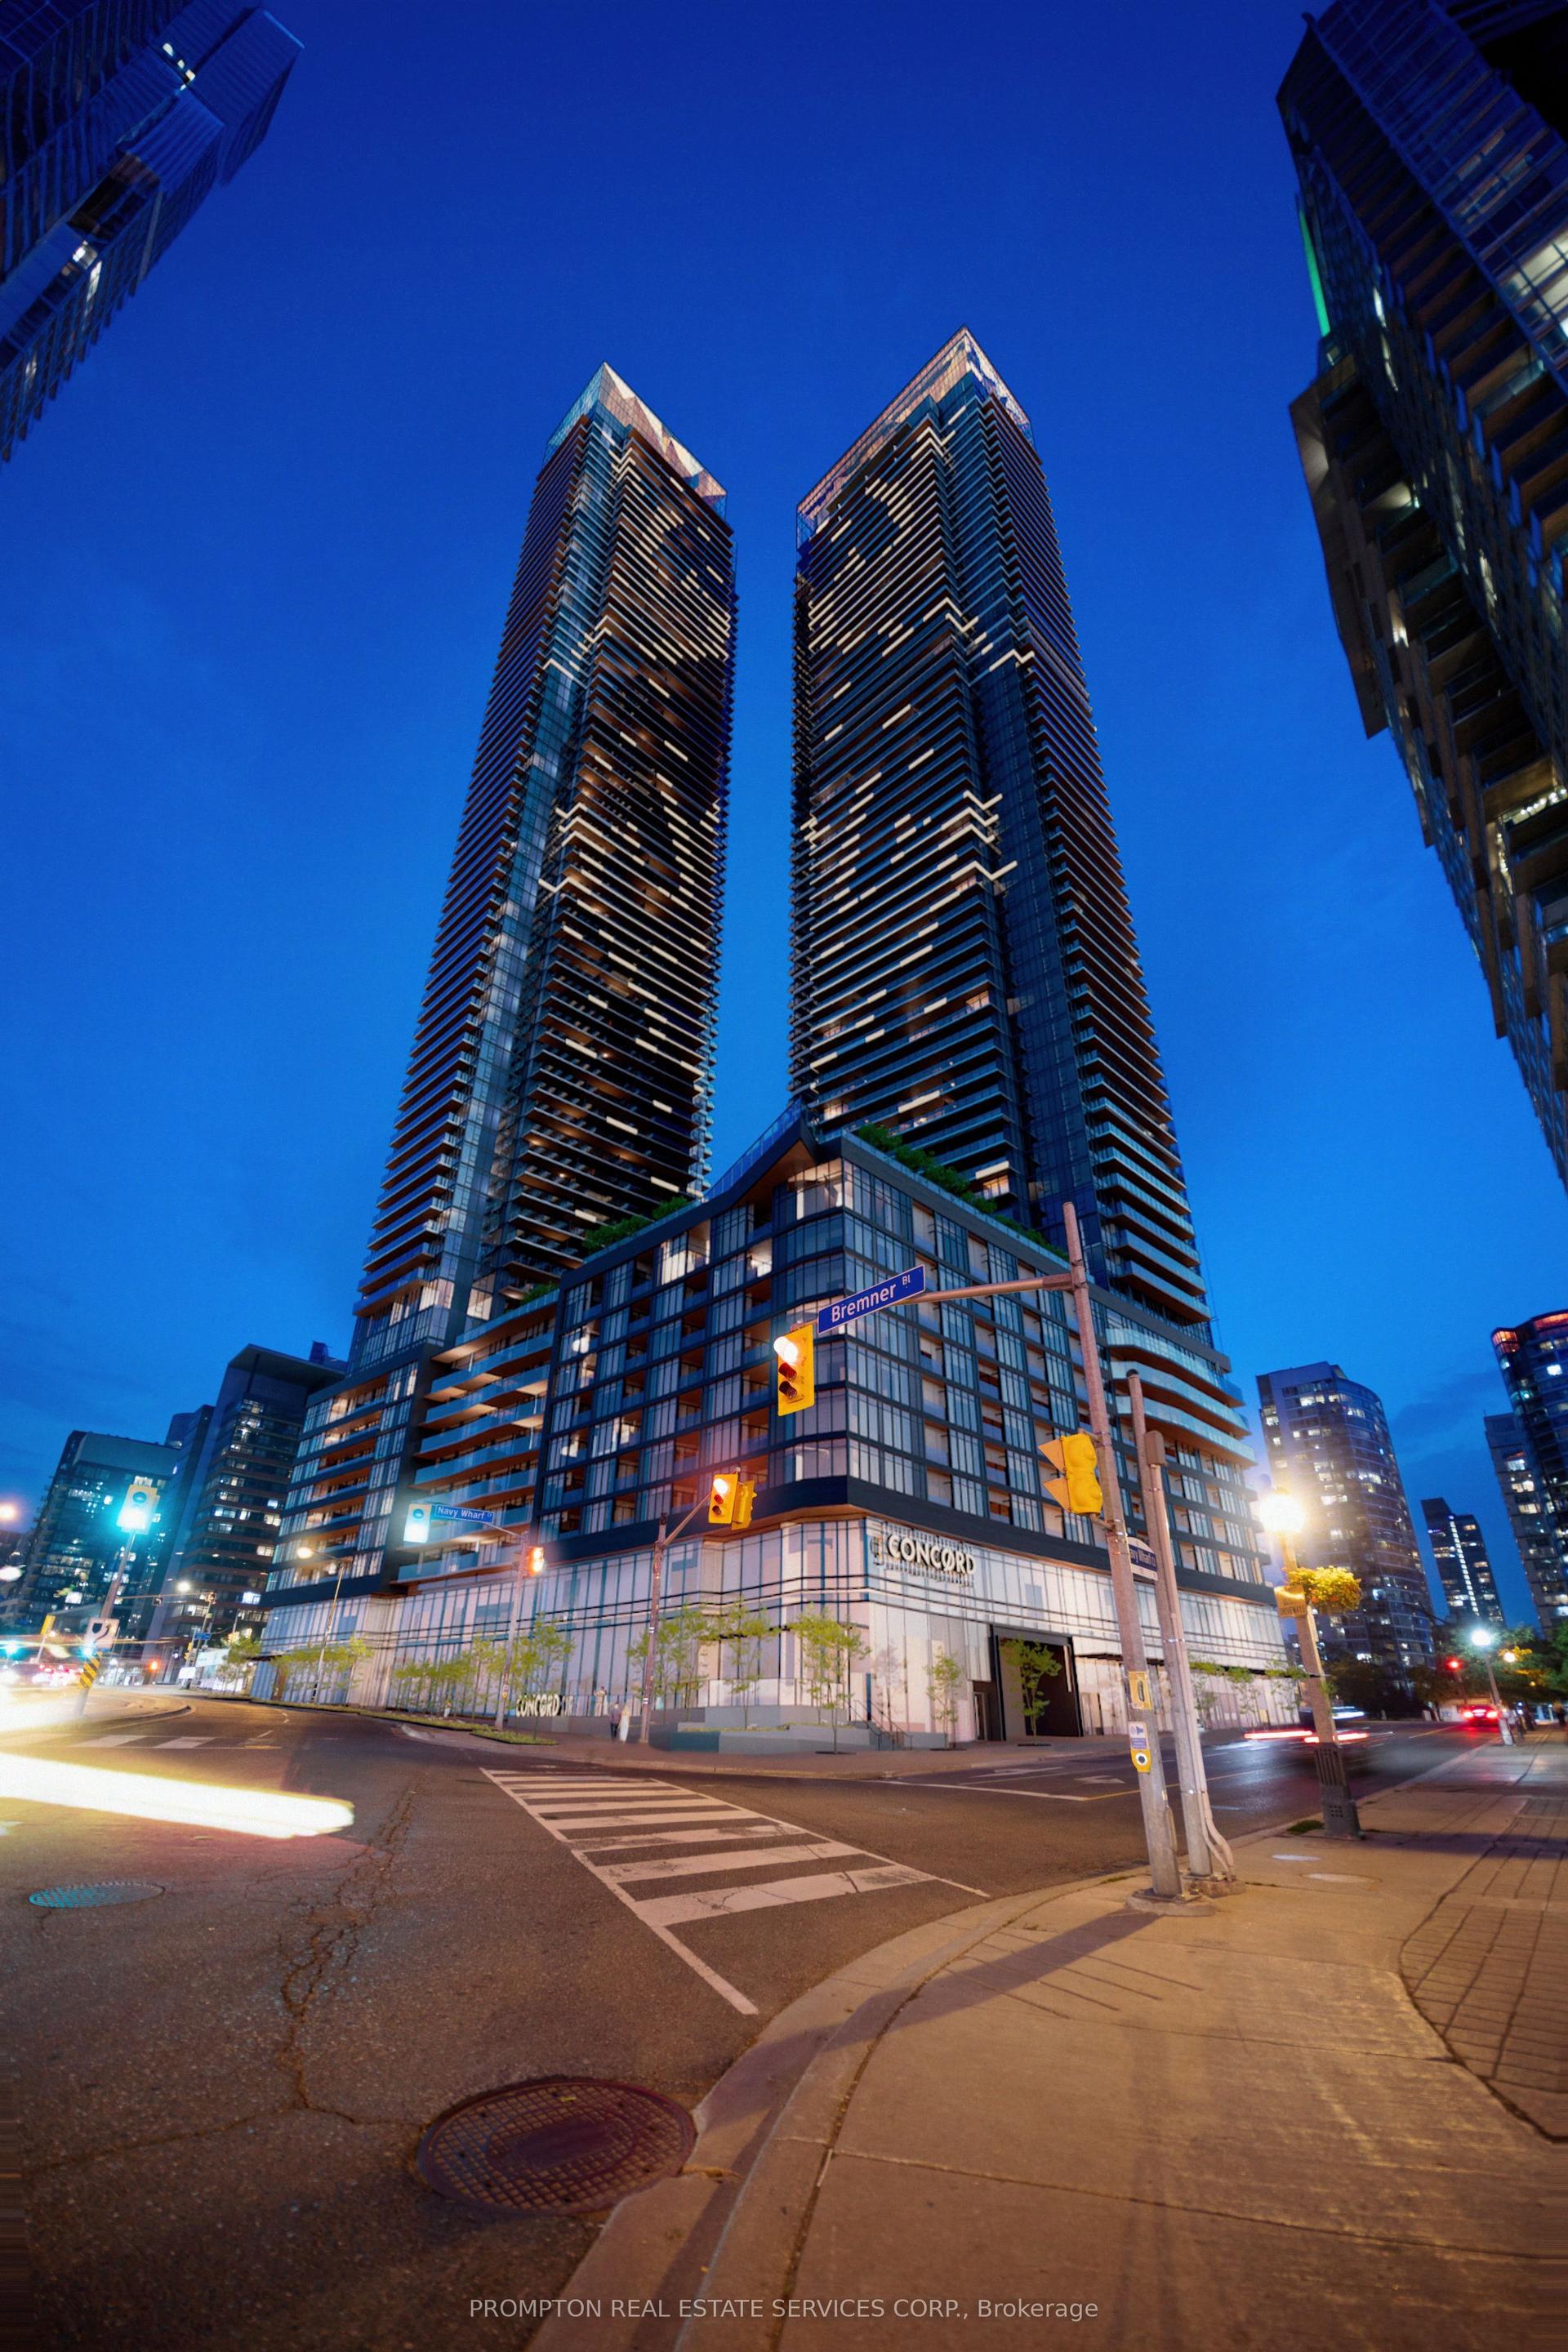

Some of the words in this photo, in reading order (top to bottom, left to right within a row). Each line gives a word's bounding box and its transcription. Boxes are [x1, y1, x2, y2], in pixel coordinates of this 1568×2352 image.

[831, 1283, 897, 1323] Bremner
[902, 1274, 911, 1286] Bl
[437, 1506, 458, 1517] Navy
[461, 1508, 485, 1520] Wharf
[516, 1692, 560, 1718] CONCORD
